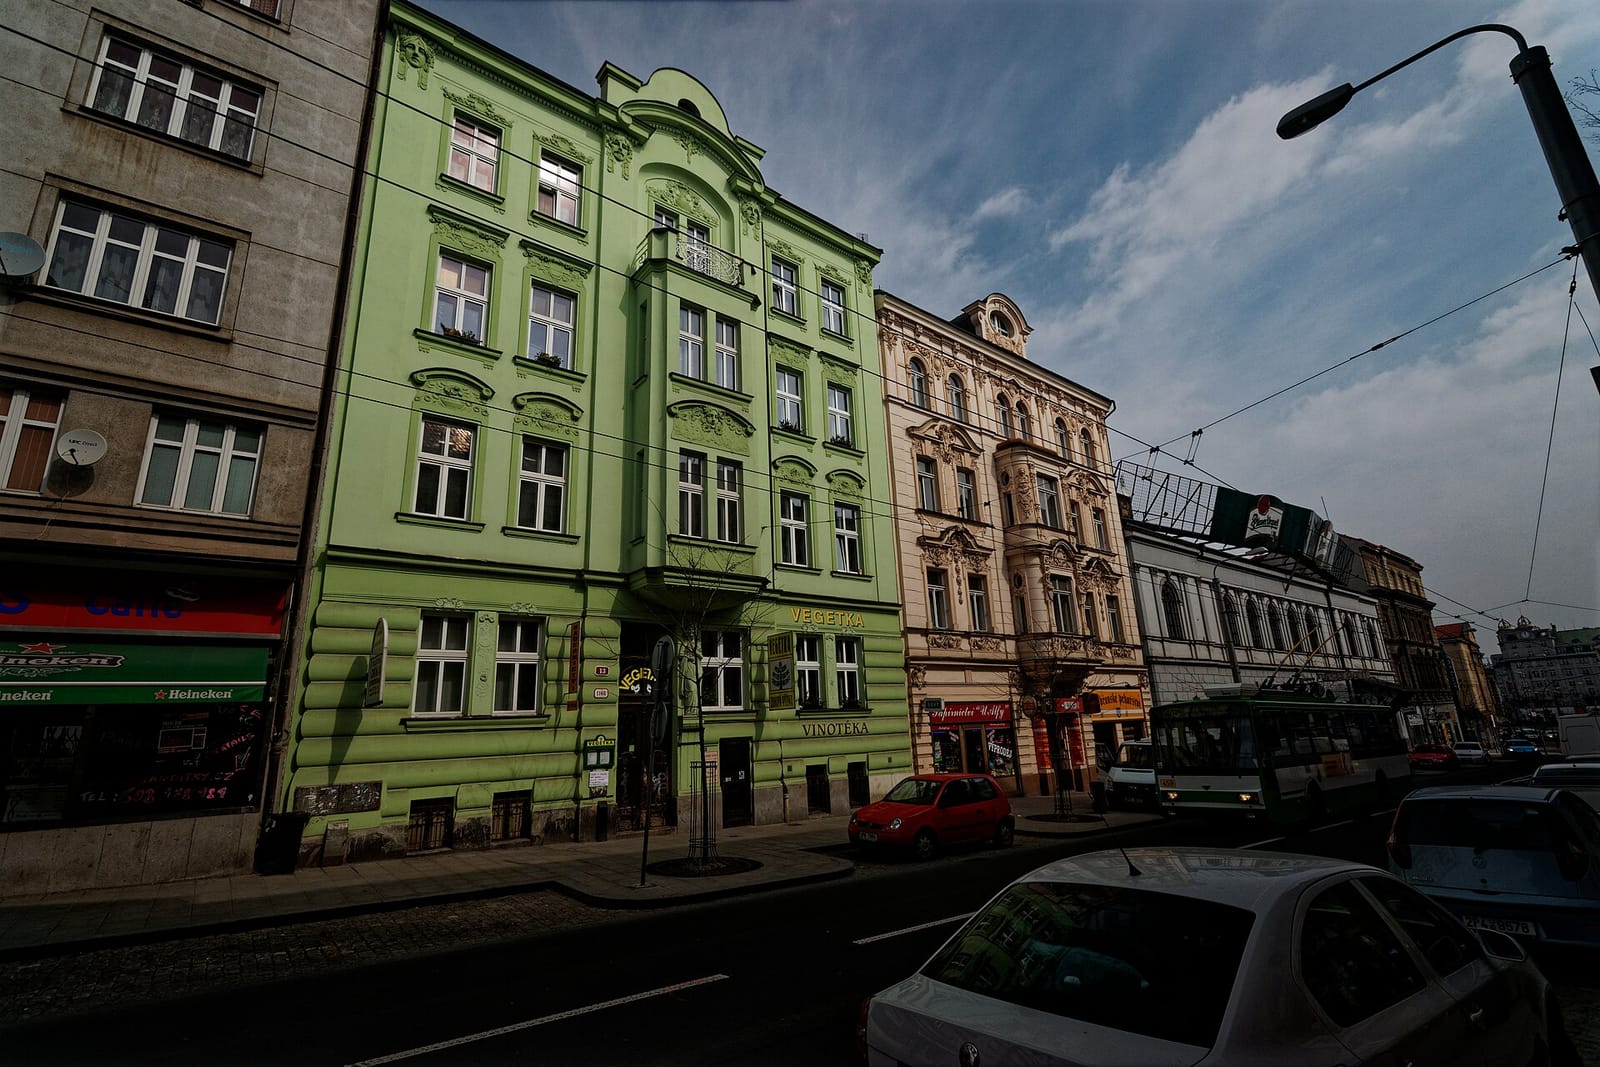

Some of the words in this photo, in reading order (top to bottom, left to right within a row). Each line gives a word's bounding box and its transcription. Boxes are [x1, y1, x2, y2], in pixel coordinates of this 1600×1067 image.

[790, 608, 864, 628] VEGETKA
[618, 667, 657, 690] VEGET
[0, 690, 52, 701] neken
[168, 690, 232, 700] Heineken
[802, 720, 869, 737] VINOTÉKA
